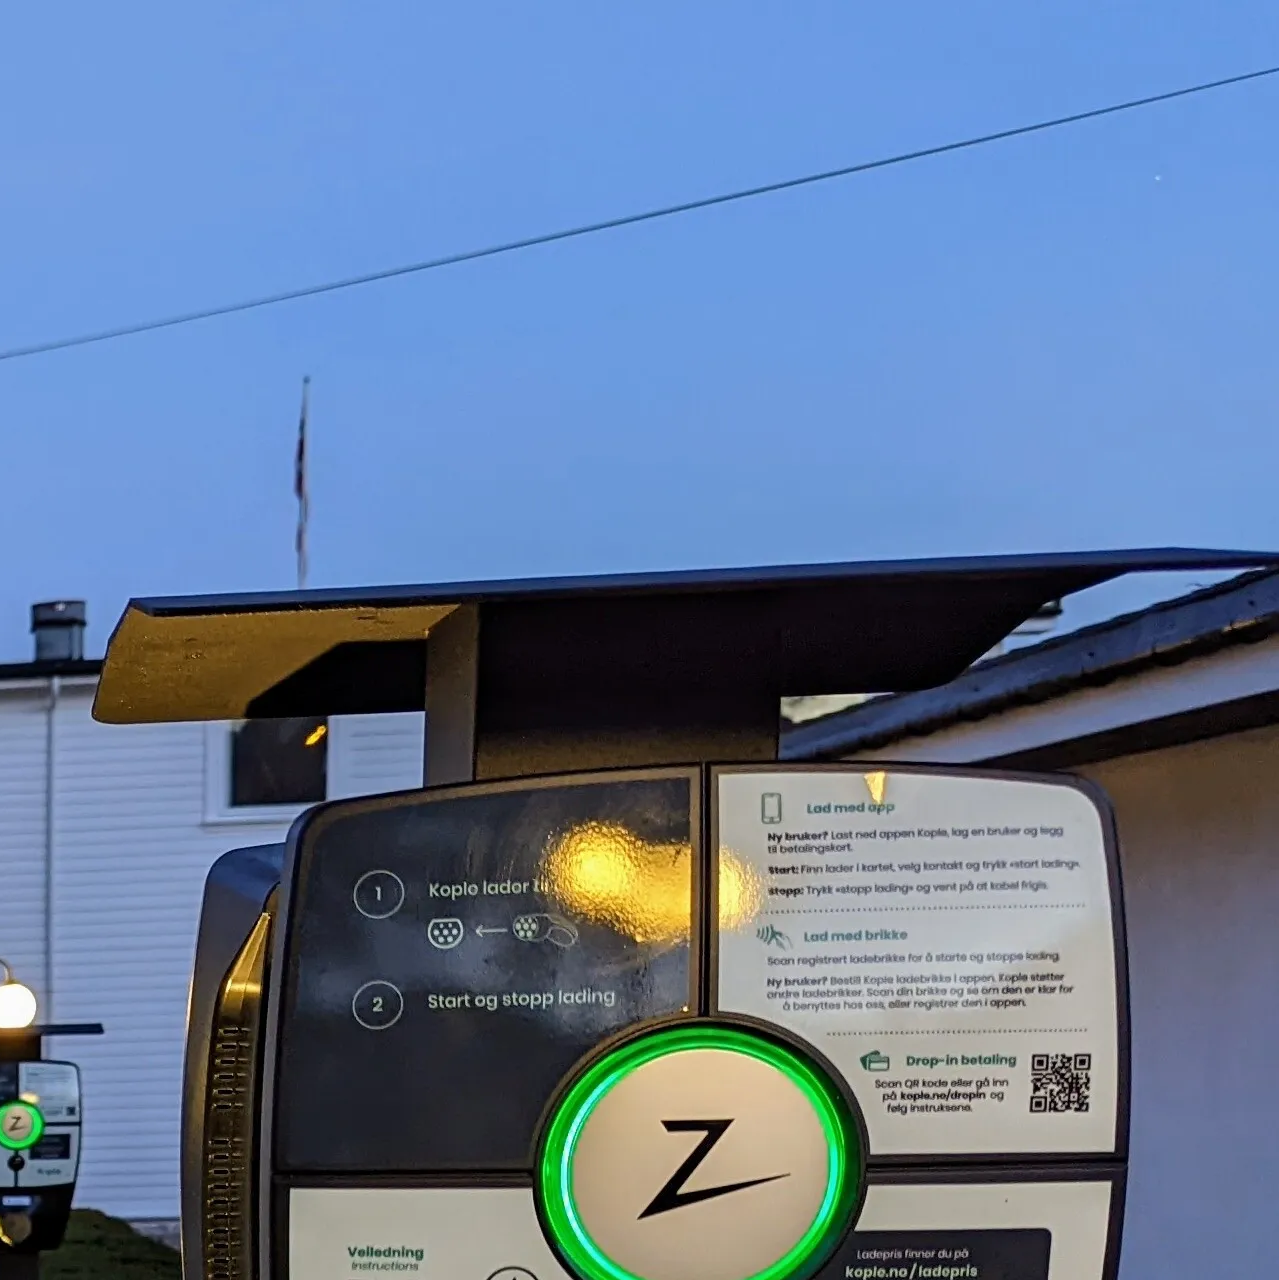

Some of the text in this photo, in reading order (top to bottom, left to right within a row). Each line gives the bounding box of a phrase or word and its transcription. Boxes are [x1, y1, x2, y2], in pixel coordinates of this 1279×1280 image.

[807, 803, 895, 814] Lad med app
[785, 831, 828, 840] bruker?
[831, 832, 852, 840] Last
[856, 830, 876, 839] ned
[879, 830, 915, 840] appen
[971, 828, 985, 836] en
[987, 827, 1021, 835] bruker
[1024, 828, 1037, 838] og
[801, 865, 823, 873] Finn
[826, 864, 853, 873] lader
[923, 861, 963, 870] kontakt
[966, 861, 980, 872] og
[375, 886, 381, 901] 1
[429, 881, 478, 900] Kople
[483, 880, 529, 894] lader
[916, 884, 930, 894] og
[933, 883, 956, 891] vent
[959, 880, 973, 893] på
[804, 929, 908, 942] Lad med brikke
[850, 953, 905, 964] ladebrikke
[908, 953, 923, 963] for
[935, 953, 967, 961] starte
[785, 976, 827, 986] bruker?
[767, 989, 799, 999] andre
[897, 987, 914, 996] din
[950, 987, 963, 997] og
[1002, 985, 1022, 994] den
[1059, 984, 1074, 993] for
[373, 989, 615, 1012] 2 Start og stopp lading
[844, 1000, 863, 1009] hos
[906, 1054, 1016, 1068] Drop-in betaling
[875, 1079, 902, 1089] Scan
[905, 1079, 919, 1089] QR
[922, 1078, 948, 1088] kode
[976, 1077, 989, 1090] gå
[882, 1091, 896, 1102] på
[857, 1250, 902, 1261] Ladepris
[938, 1250, 952, 1258] du
[954, 1249, 969, 1260] på
